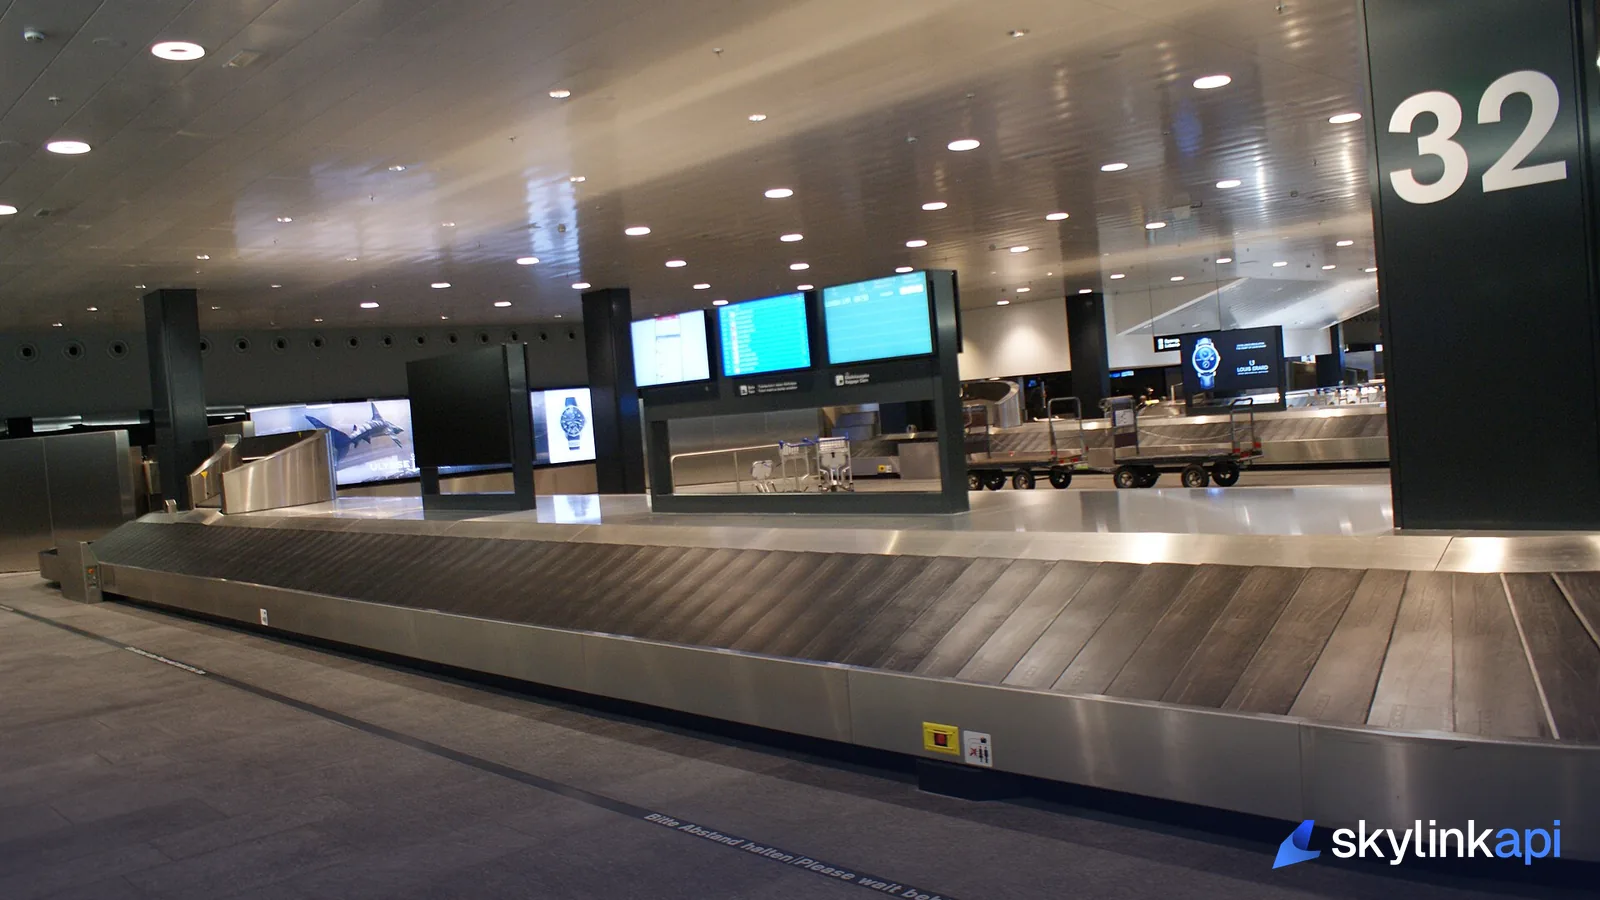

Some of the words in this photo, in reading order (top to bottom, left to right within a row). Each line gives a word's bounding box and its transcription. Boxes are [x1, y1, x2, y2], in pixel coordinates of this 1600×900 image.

[1388, 70, 1567, 204] 32
[369, 460, 411, 471] ULYSE
[643, 813, 679, 827] Bitte
[678, 823, 745, 846] Abstand
[858, 877, 902, 893] wait
